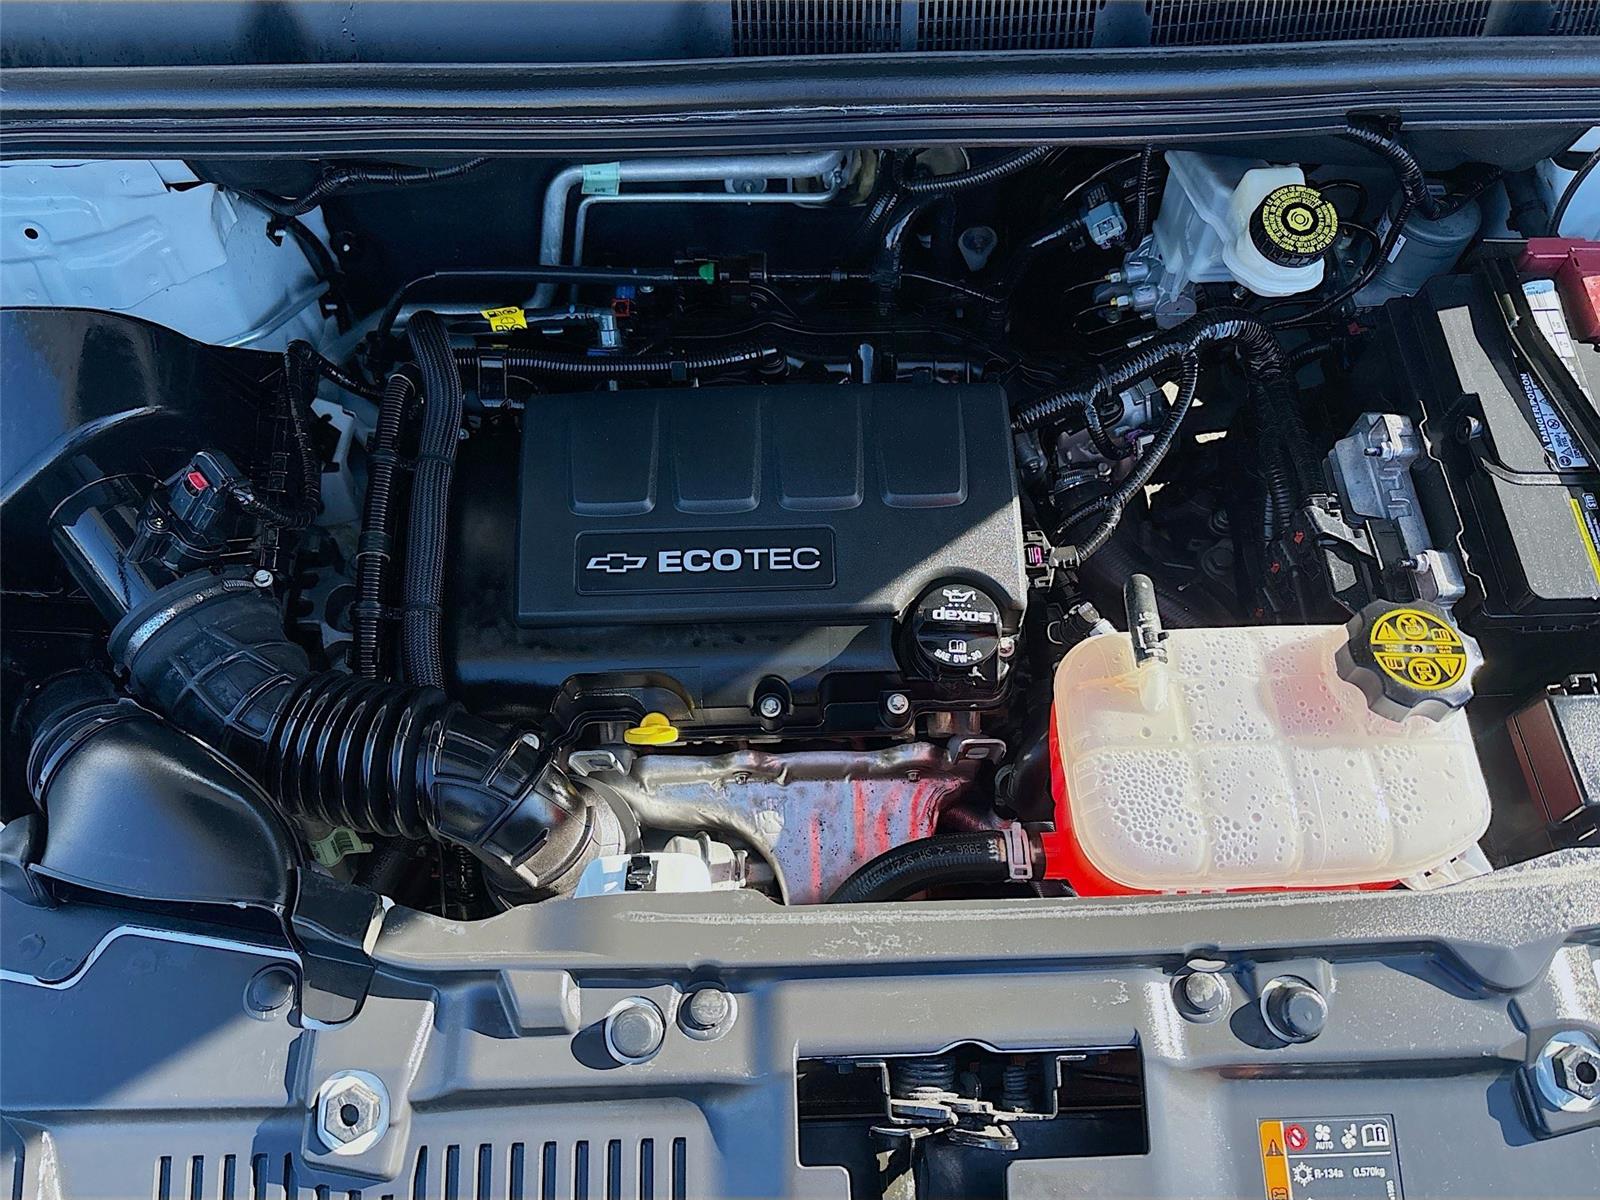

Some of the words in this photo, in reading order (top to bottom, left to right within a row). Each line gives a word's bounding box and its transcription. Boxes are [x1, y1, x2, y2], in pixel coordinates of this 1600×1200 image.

[1520, 373, 1550, 443] DANGER/POISON
[658, 547, 821, 573] ECOTEC
[932, 606, 993, 623] dexos
[934, 648, 952, 662] SAE
[953, 649, 983, 663] 5W-30
[1315, 1142, 1334, 1150] AUTO
[1314, 1168, 1344, 1179] R-134a
